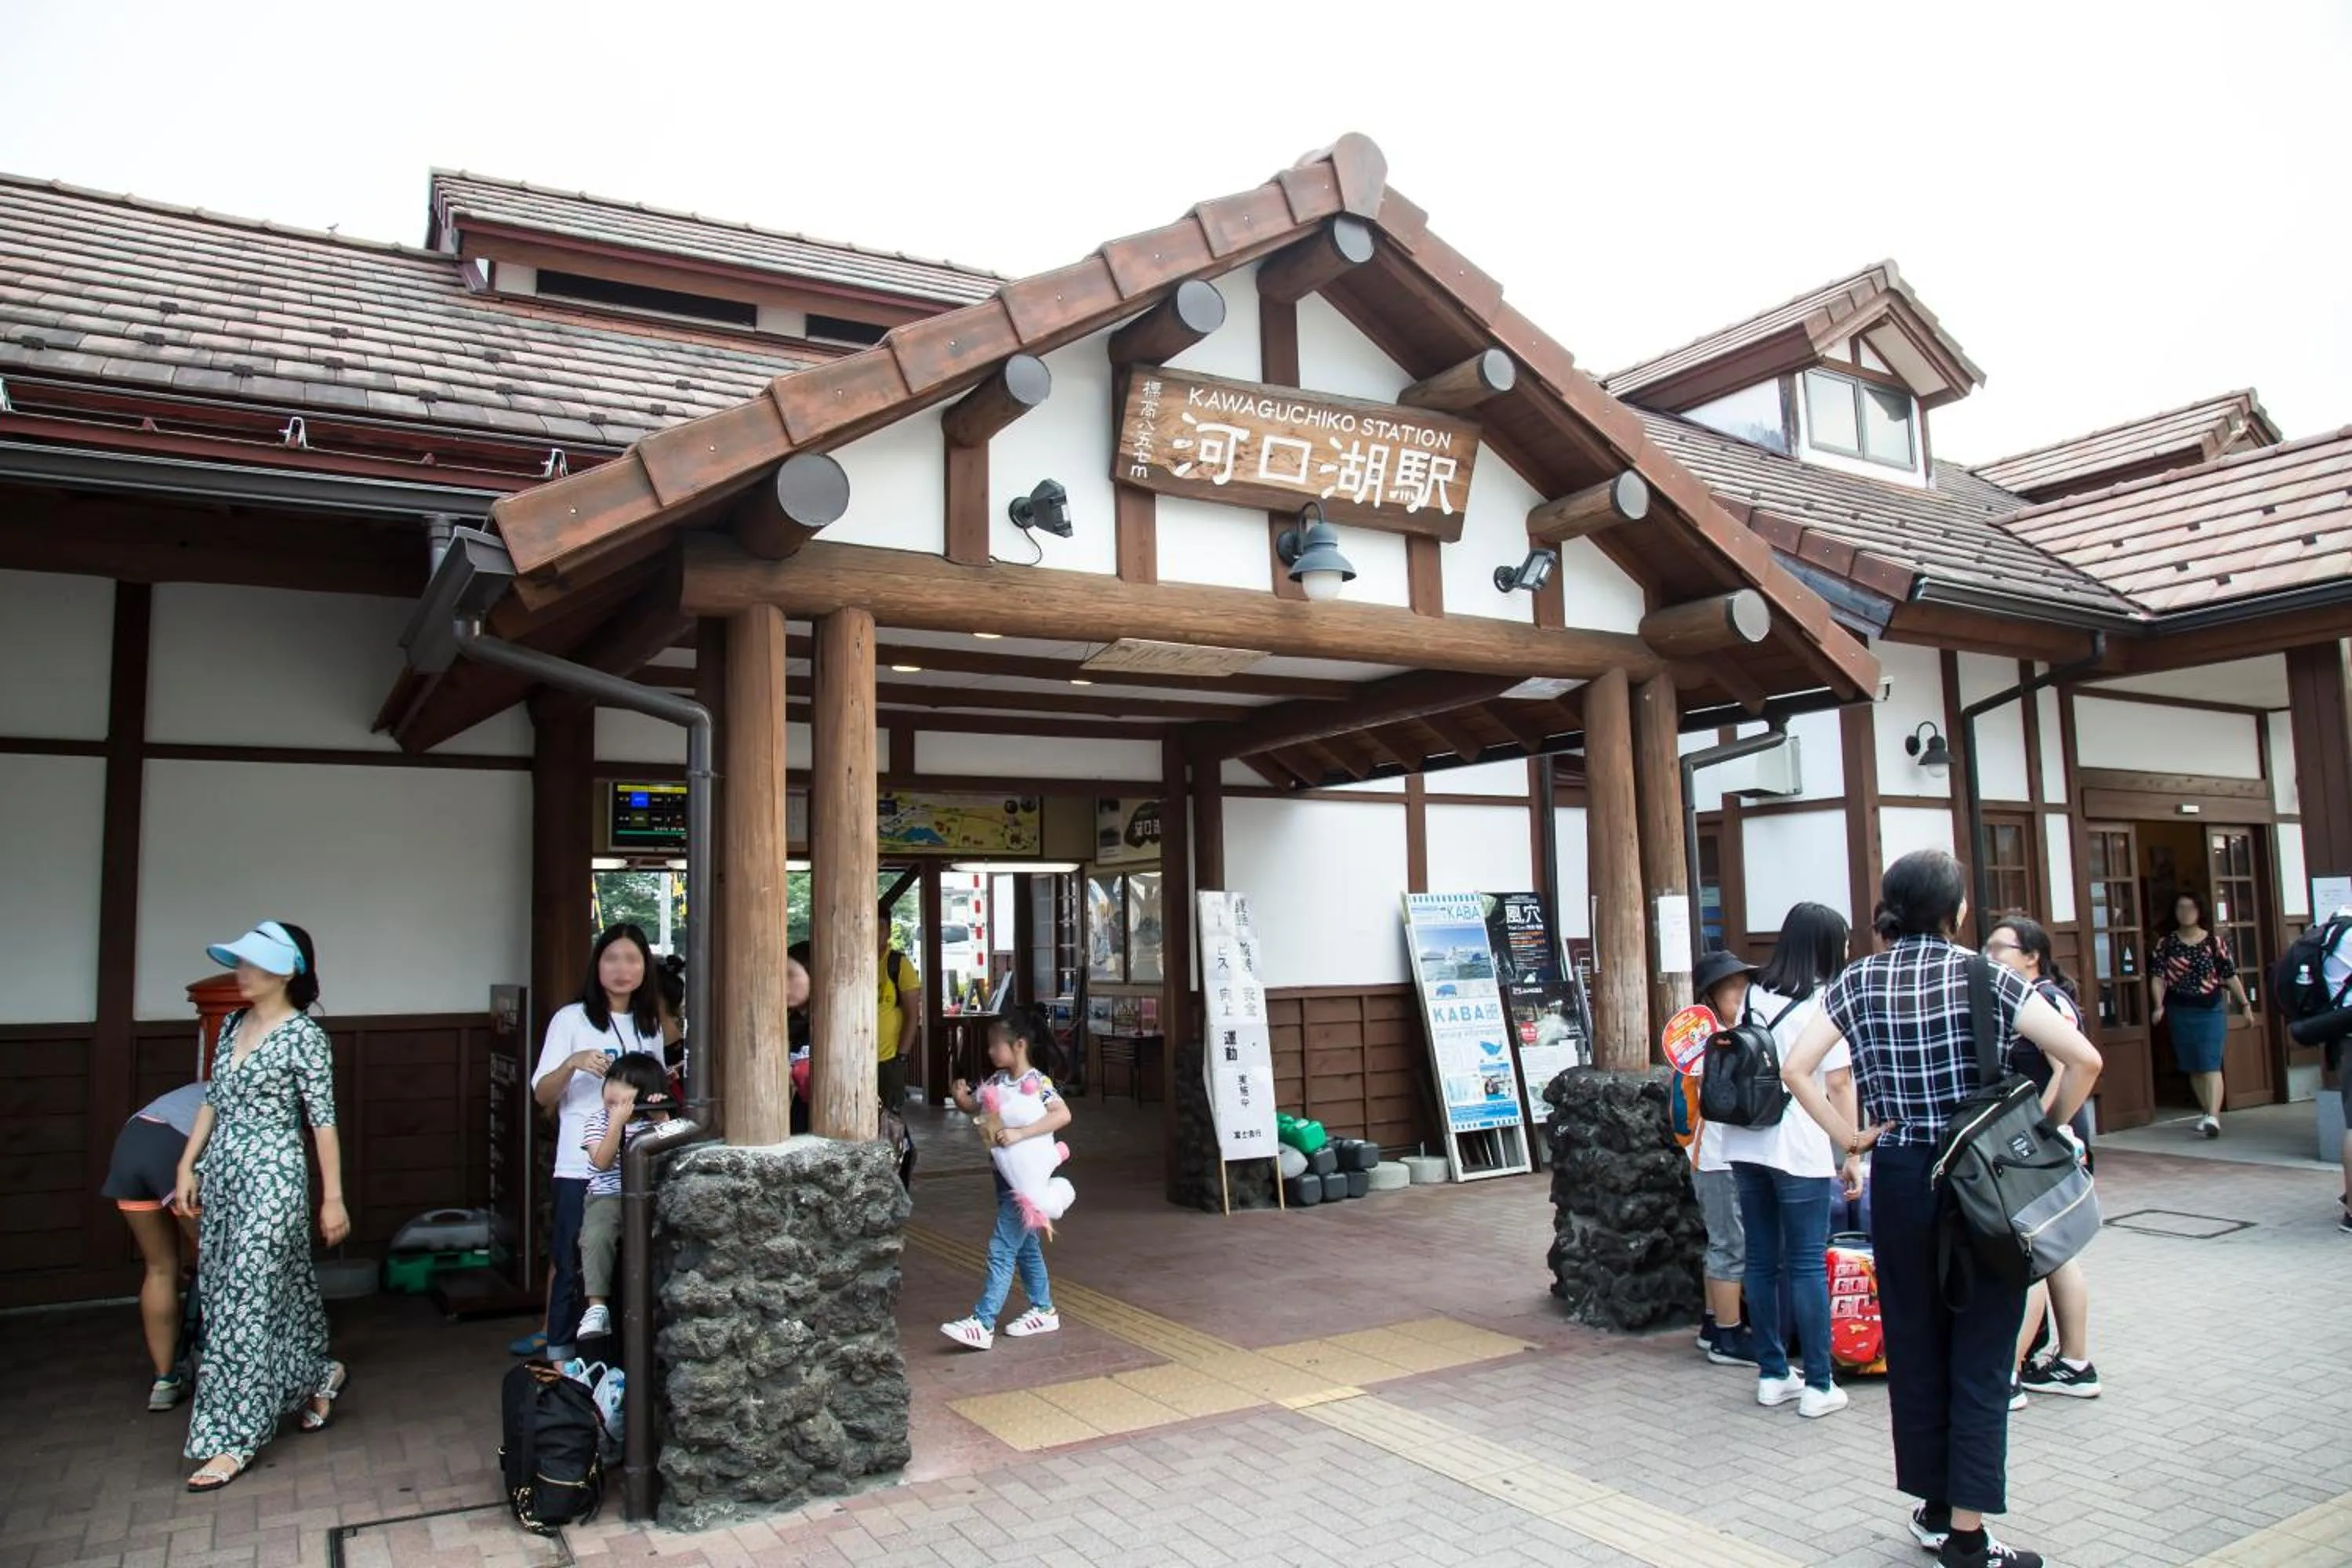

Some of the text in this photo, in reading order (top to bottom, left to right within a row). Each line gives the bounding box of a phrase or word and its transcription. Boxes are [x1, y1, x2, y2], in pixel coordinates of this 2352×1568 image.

[1188, 386, 1451, 449] KAWAGUCHIKO STATION
[1172, 412, 1457, 515] 河口湖駅
[1446, 906, 1480, 920] KABA
[1504, 904, 1543, 924] 風穴
[1432, 1004, 1485, 1023] KABA
